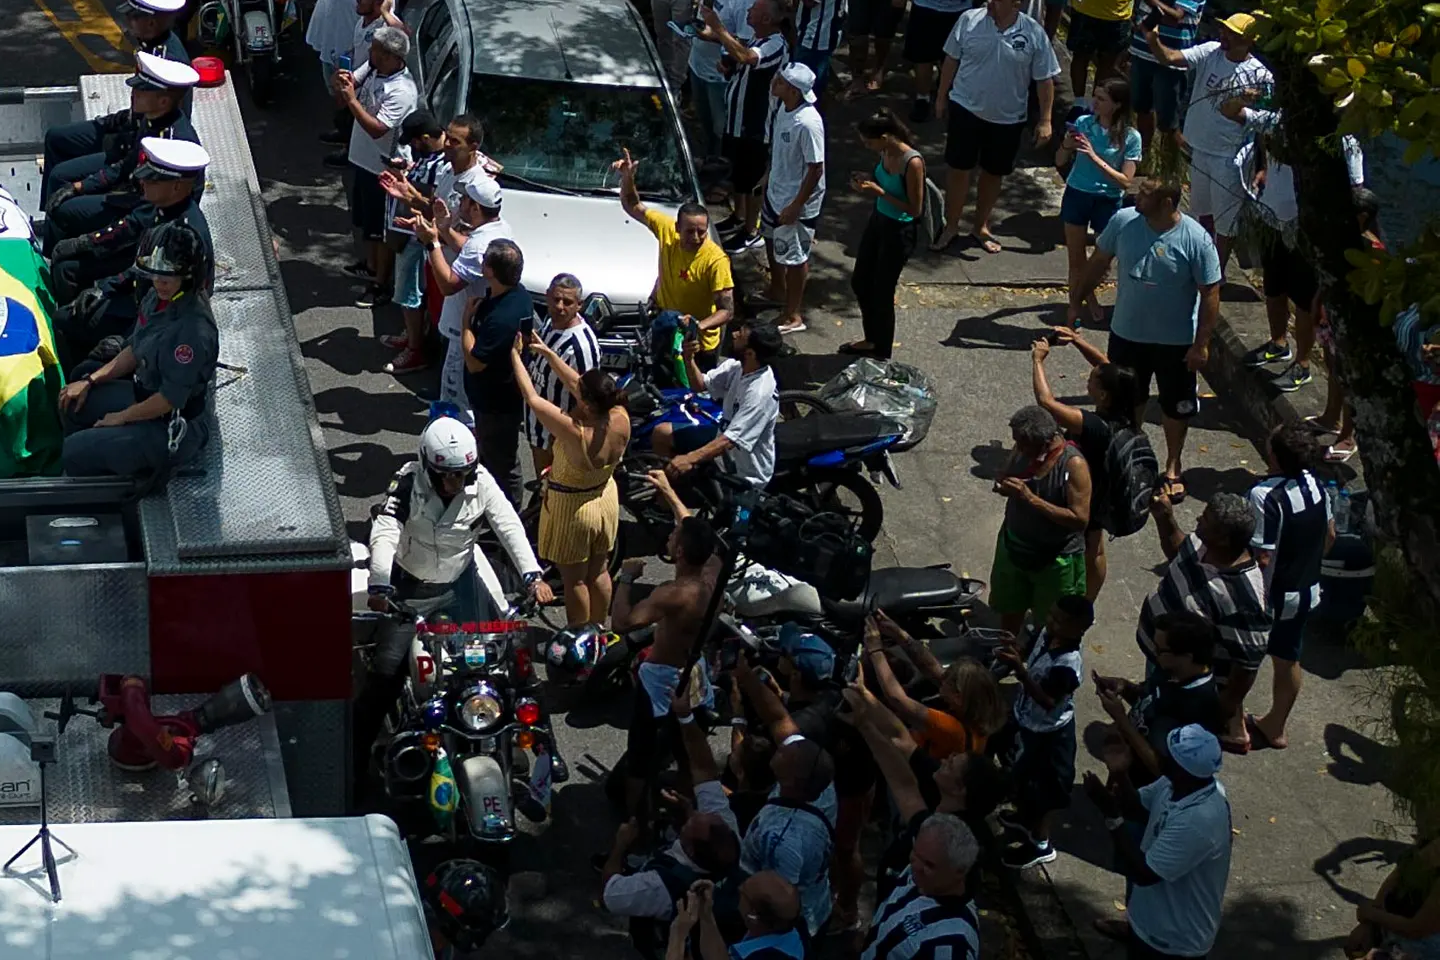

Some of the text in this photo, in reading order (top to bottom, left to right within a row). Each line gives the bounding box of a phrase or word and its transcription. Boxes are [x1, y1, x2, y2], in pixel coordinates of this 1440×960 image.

[465, 452, 474, 463] E
[417, 655, 434, 683] P
[484, 796, 502, 812] PE
